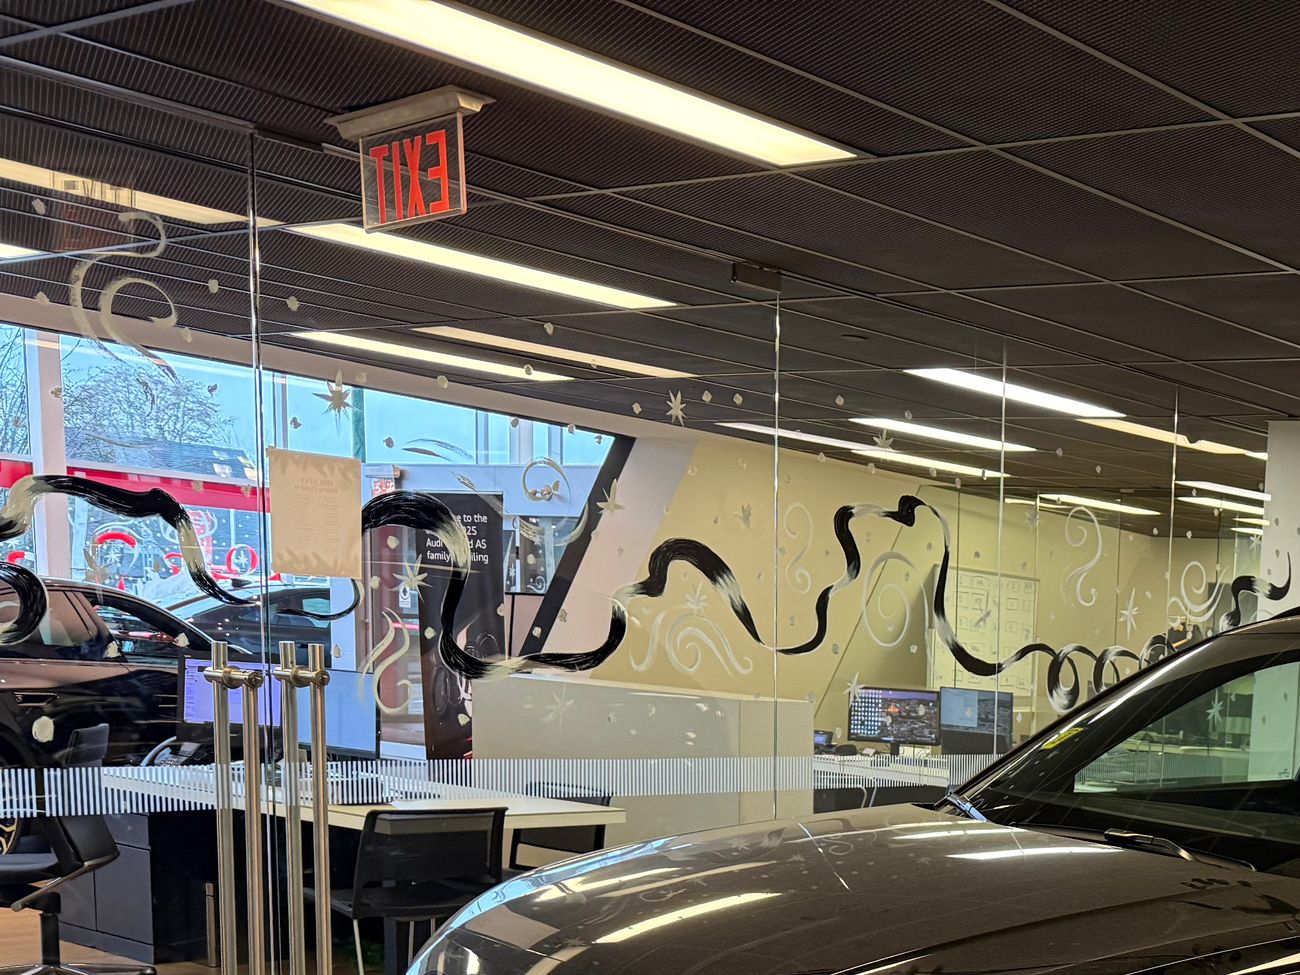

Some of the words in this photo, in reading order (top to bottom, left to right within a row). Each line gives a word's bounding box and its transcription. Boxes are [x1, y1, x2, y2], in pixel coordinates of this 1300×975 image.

[463, 514, 472, 522] to
[473, 513, 487, 522] the
[475, 539, 486, 549] A5
[427, 550, 450, 562] family
